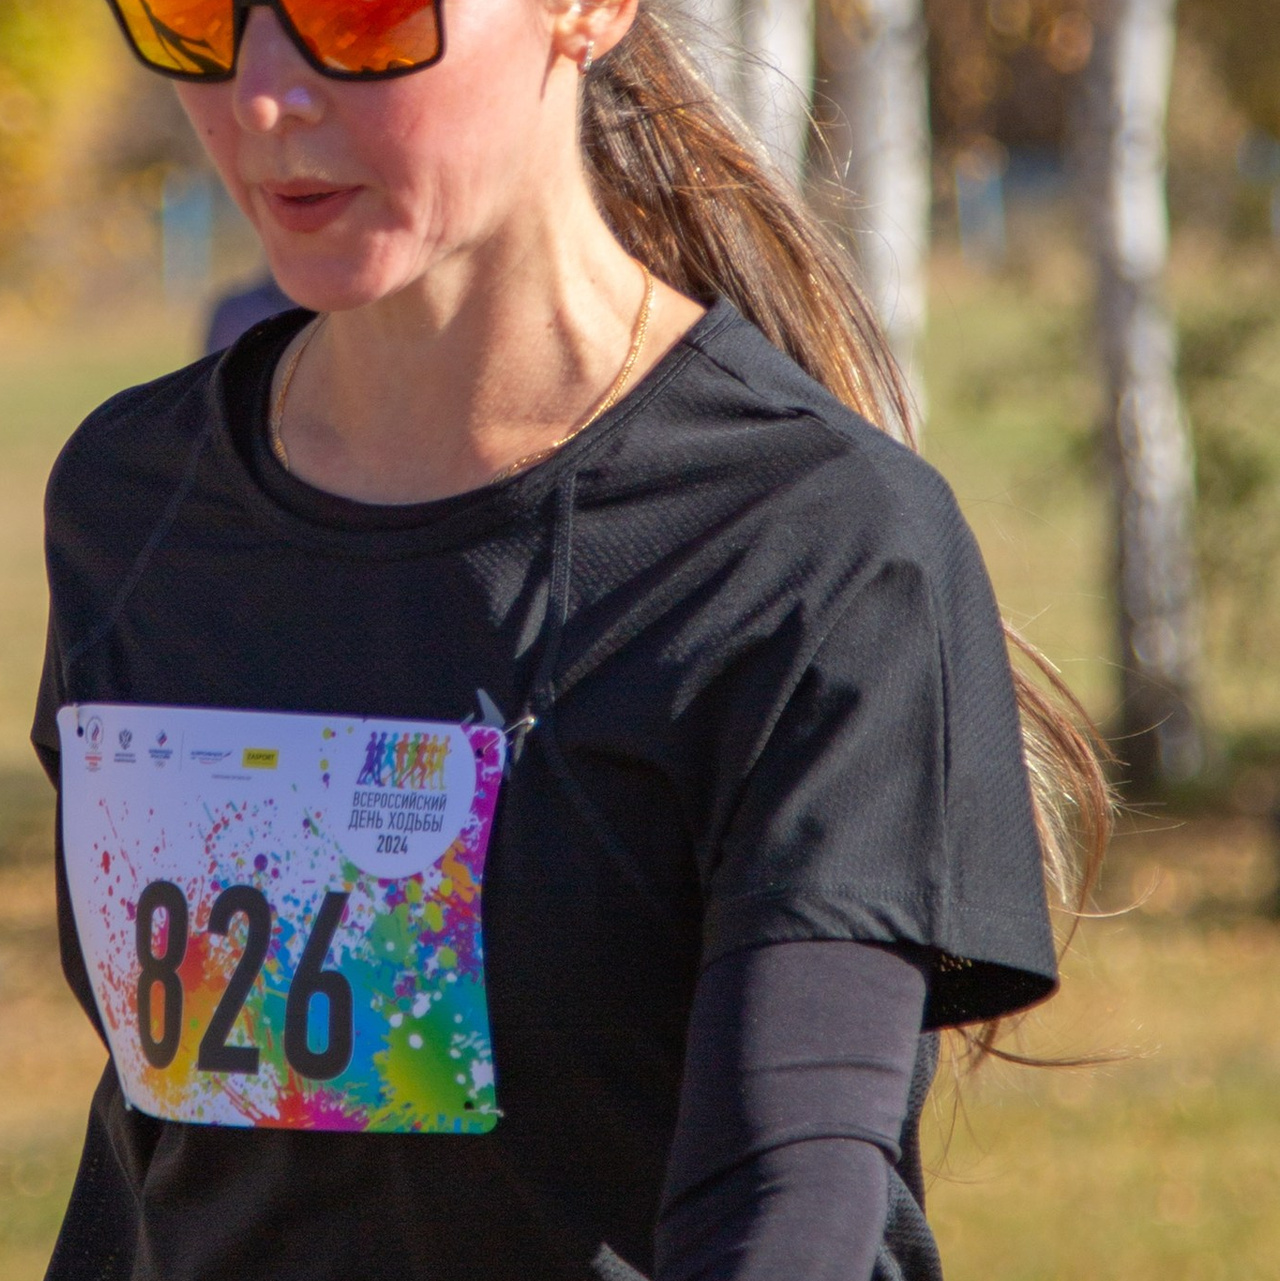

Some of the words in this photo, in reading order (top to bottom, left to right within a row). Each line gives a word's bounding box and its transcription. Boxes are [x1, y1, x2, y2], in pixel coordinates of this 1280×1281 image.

[352, 791, 448, 812] ВСЕРОССИЙСКИЙ
[348, 809, 384, 830] ДЕНЬ
[388, 811, 444, 833] ХОДЬБЫ
[376, 834, 409, 854] 2024
[136, 880, 354, 1081] 826
